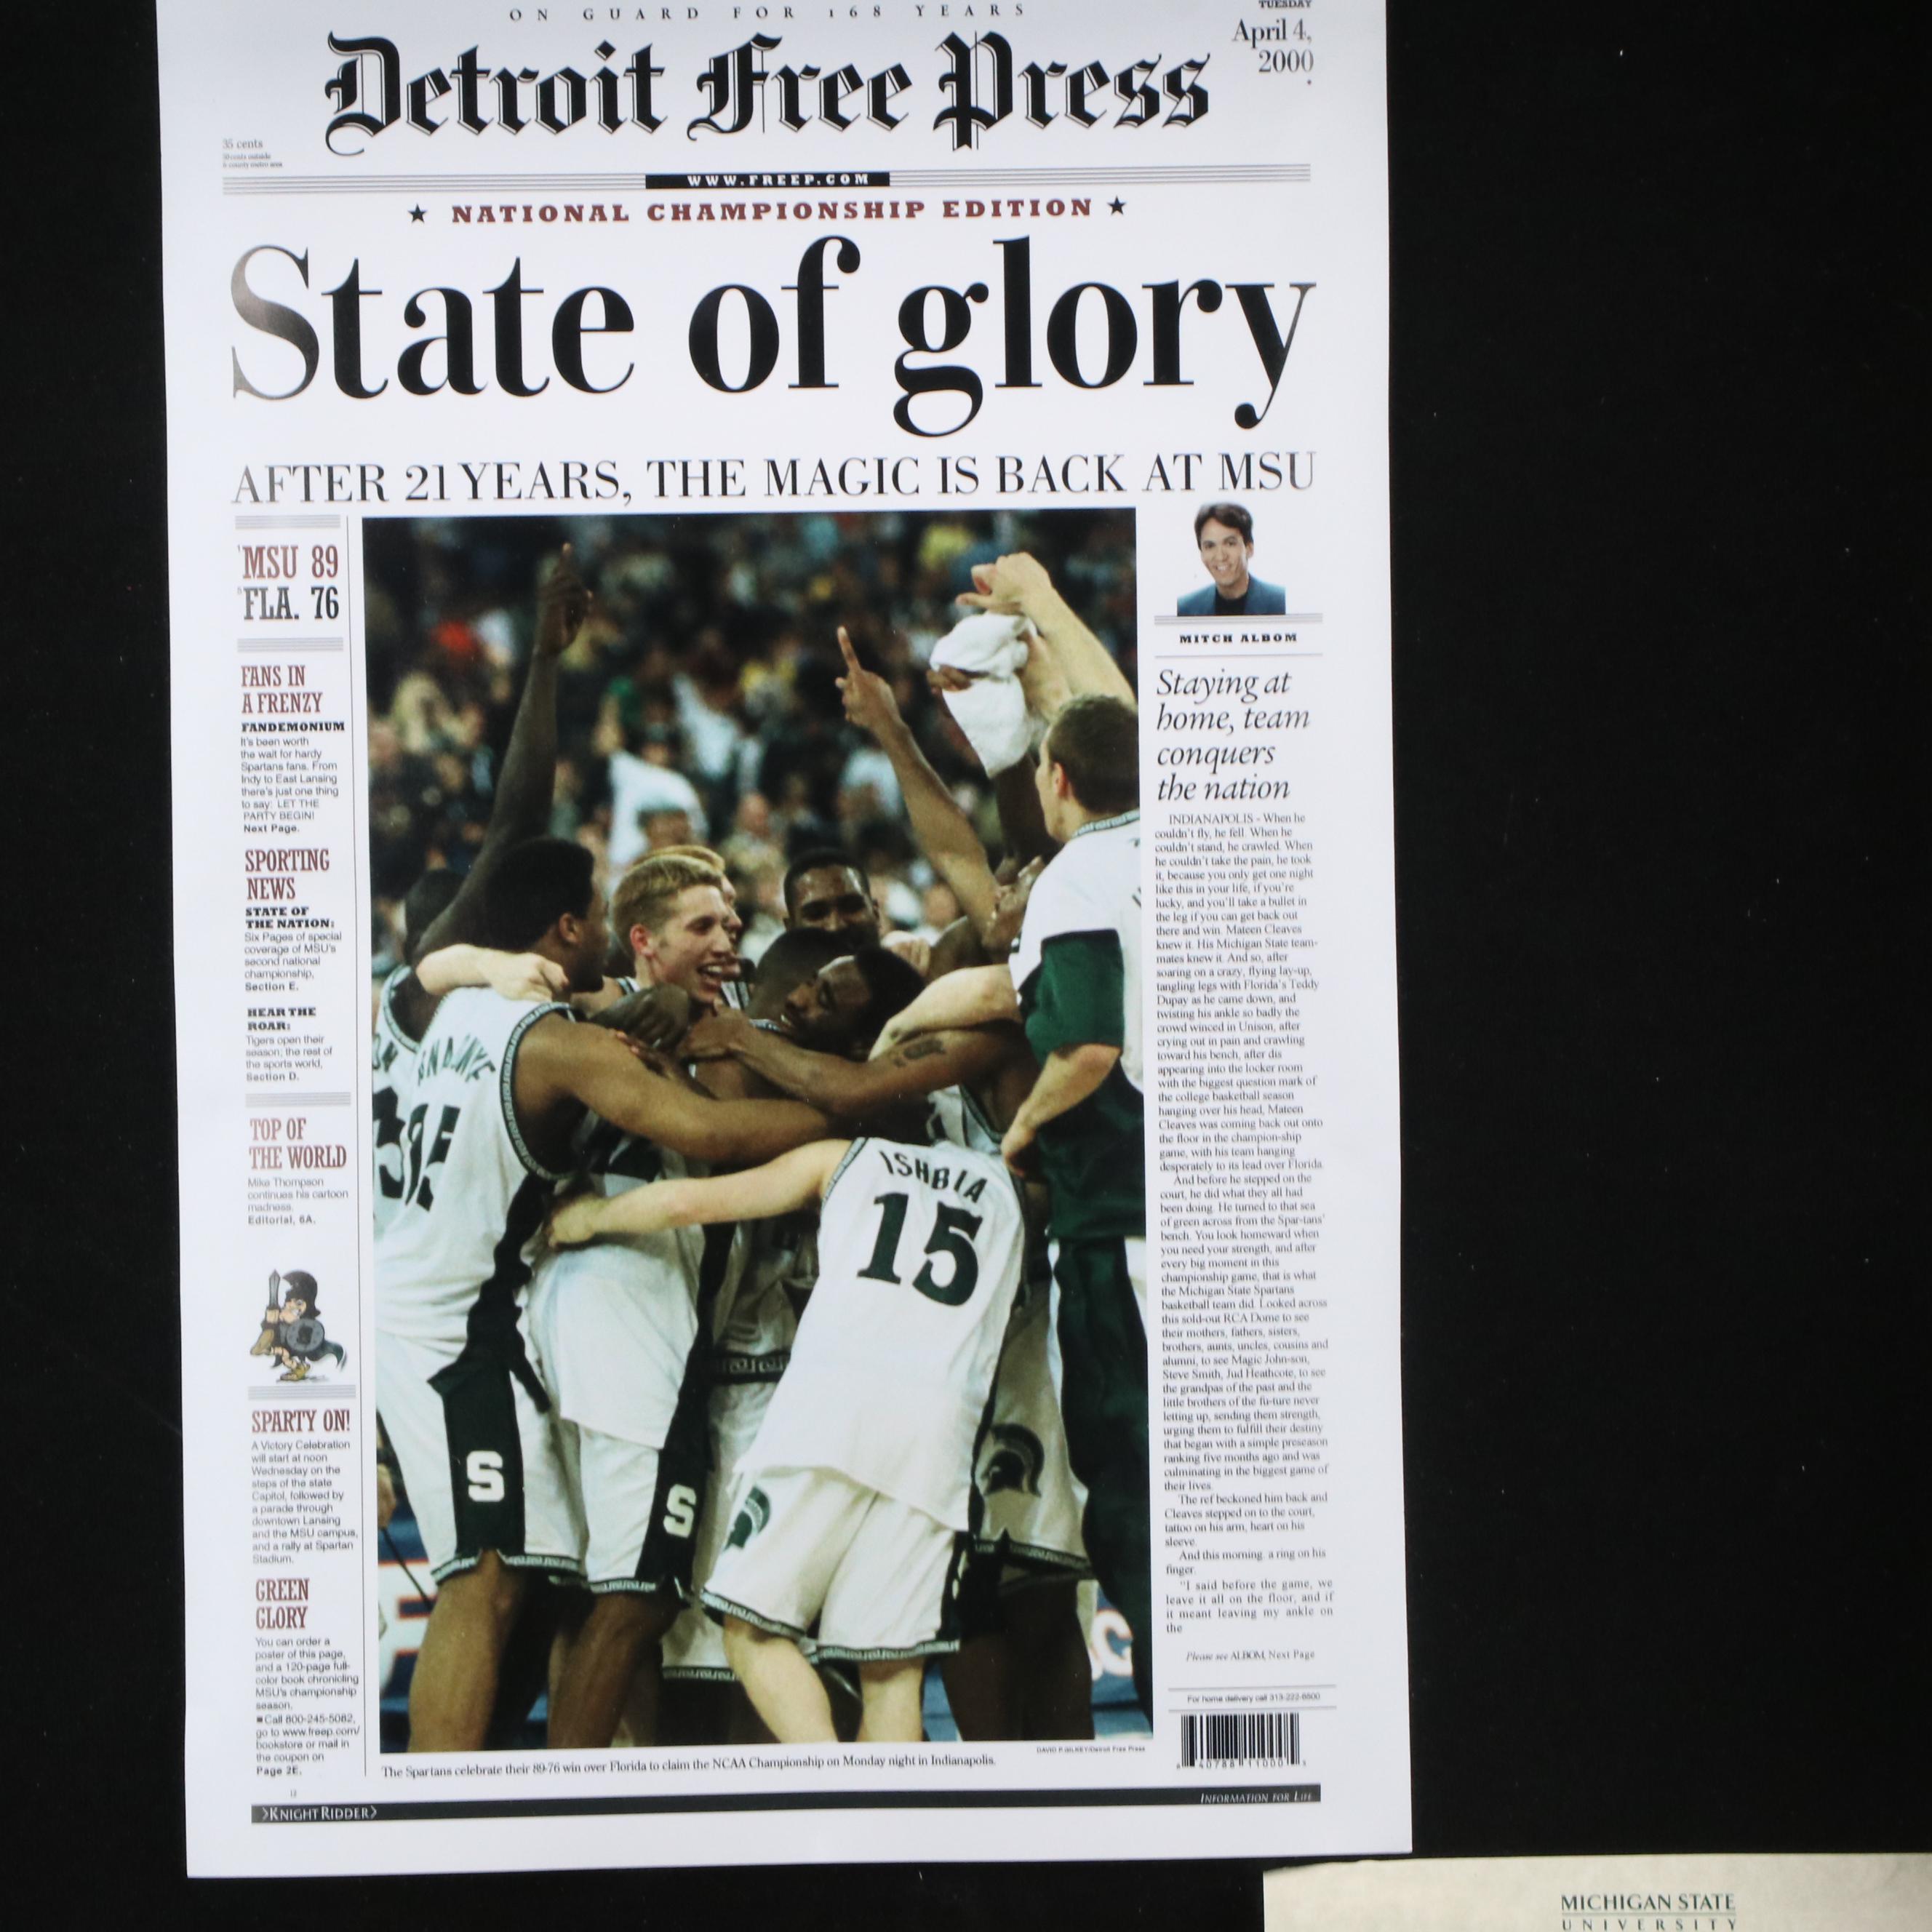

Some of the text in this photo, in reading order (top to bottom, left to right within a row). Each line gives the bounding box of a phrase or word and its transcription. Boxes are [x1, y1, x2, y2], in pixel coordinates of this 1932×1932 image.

[508, 7, 548, 21] ON
[582, 7, 699, 21] GUARD
[917, 4, 1026, 18] YEARS
[1258, 0, 1312, 9] TUESDAY
[1232, 17, 1312, 49] April 4,
[1258, 49, 1314, 73] 2000
[325, 31, 1210, 156] Detroit Free Press
[236, 137, 264, 149] cents
[686, 174, 871, 188] WWW.FREEP.COM
[451, 199, 1093, 223] NATIONAL CHAMPIONSHIP EDITION
[230, 235, 1317, 437] State of glory
[233, 452, 1315, 503] AFTER 21 YEARS, THE MAGIC IS BACK AT MSU
[243, 545, 338, 579] MSU 89
[244, 586, 339, 620] FLA. 76
[1179, 633, 1297, 644] MITCH ALBOM
[242, 665, 305, 687] FANS IN
[1157, 668, 1292, 705] Staying at
[242, 692, 322, 714] A FRENZY
[1157, 702, 1309, 734] home, team
[242, 721, 346, 733] FANDEMONIUM
[240, 736, 309, 747] It's been worth
[240, 749, 322, 762] the wait for hardy
[1157, 746, 1275, 774] conquers
[241, 759, 338, 775] Spartans fans. From
[241, 773, 338, 786] Indy to East Lansing
[1158, 772, 1290, 801] the nation
[241, 785, 339, 799] there's just one thing
[241, 799, 251, 810] to
[277, 798, 297, 810] LET
[298, 798, 320, 810] THE
[243, 810, 277, 821] PARTY
[1168, 812, 1306, 826] INDIANAPOLIS When he
[243, 823, 300, 835] Next Page.
[1154, 828, 1194, 839] couldn't
[1214, 827, 1226, 839] he
[1250, 826, 1279, 838] When
[1280, 826, 1293, 837] he
[245, 849, 330, 872] SPORTING
[247, 877, 295, 900] NEWS
[245, 906, 309, 917] STATE OF
[245, 918, 335, 930] THE NATION:
[244, 981, 285, 992] Section
[247, 1007, 316, 1018] HEAR THE
[247, 1021, 291, 1031] ROAR:
[250, 1117, 306, 1141] TOP OF
[250, 1146, 346, 1169] THE WORLD
[879, 1150, 987, 1203] ISHBIA
[247, 1214, 295, 1226] Editorial,
[857, 1192, 983, 1306] 15
[1161, 1284, 1295, 1299] the Michigan State Spartans
[252, 1409, 350, 1432] SPARTY ON!
[251, 1439, 351, 1453] A Victory Celebration
[251, 1453, 328, 1464] will start at noon
[466, 1450, 505, 1501] S
[663, 1484, 696, 1538] S
[256, 1578, 309, 1601] GREEN
[256, 1606, 308, 1629] GLORY
[1268, 1650, 1290, 1660] Next
[1293, 1649, 1315, 1661] Page
[1186, 1695, 1199, 1704] For
[256, 1765, 283, 1778] Page
[381, 1766, 403, 1778] The
[405, 1765, 452, 1780] Spartans
[454, 1763, 504, 1777] celebrate
[505, 1763, 530, 1776] their
[562, 1762, 581, 1773] win
[583, 1764, 607, 1773] over
[610, 1760, 647, 1773] Florida
[649, 1760, 660, 1771] to
[662, 1759, 690, 1771] claim
[692, 1758, 710, 1770] the
[712, 1757, 746, 1770] NCAA
[749, 1755, 825, 1771] Championship
[826, 1758, 840, 1767] on
[843, 1755, 886, 1768] Monday
[888, 1754, 916, 1768] night
[918, 1755, 928, 1766] in
[931, 1754, 996, 1768] Indianapolis.
[1561, 1893, 1736, 1911] MICHIGAN STATE
[1562, 1917, 1736, 1931] UNIVERSITY
